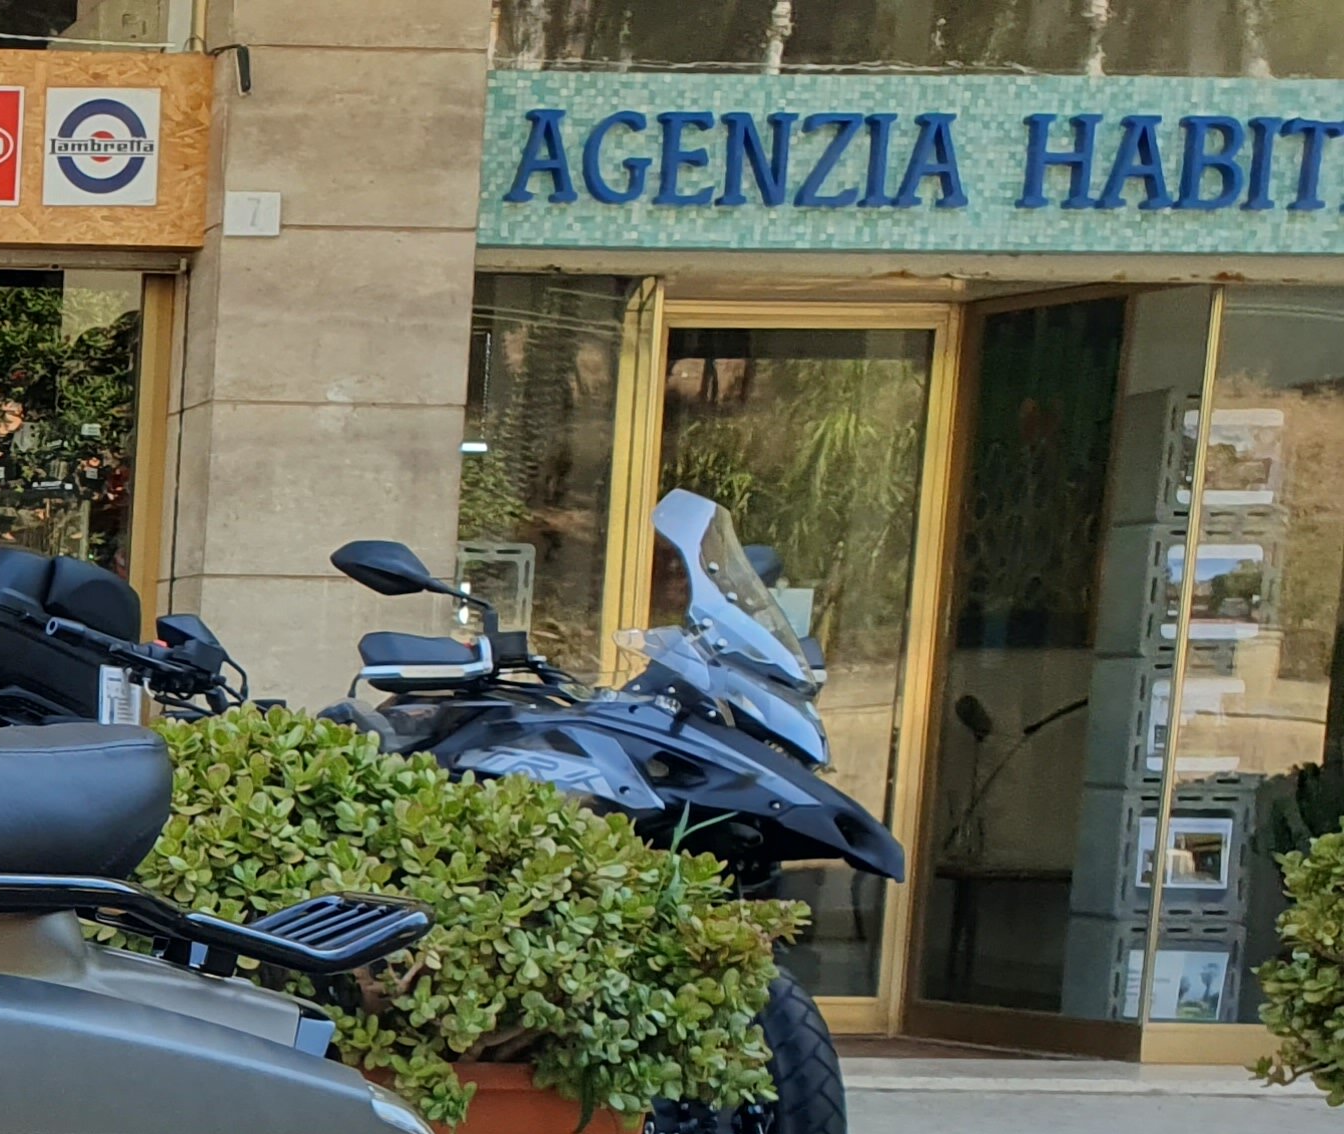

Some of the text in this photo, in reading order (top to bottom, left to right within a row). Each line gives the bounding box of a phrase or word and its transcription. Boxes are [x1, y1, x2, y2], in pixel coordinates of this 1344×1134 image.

[50, 138, 154, 155] Lambretta
[502, 108, 1344, 211] AGENZIA HABIT
